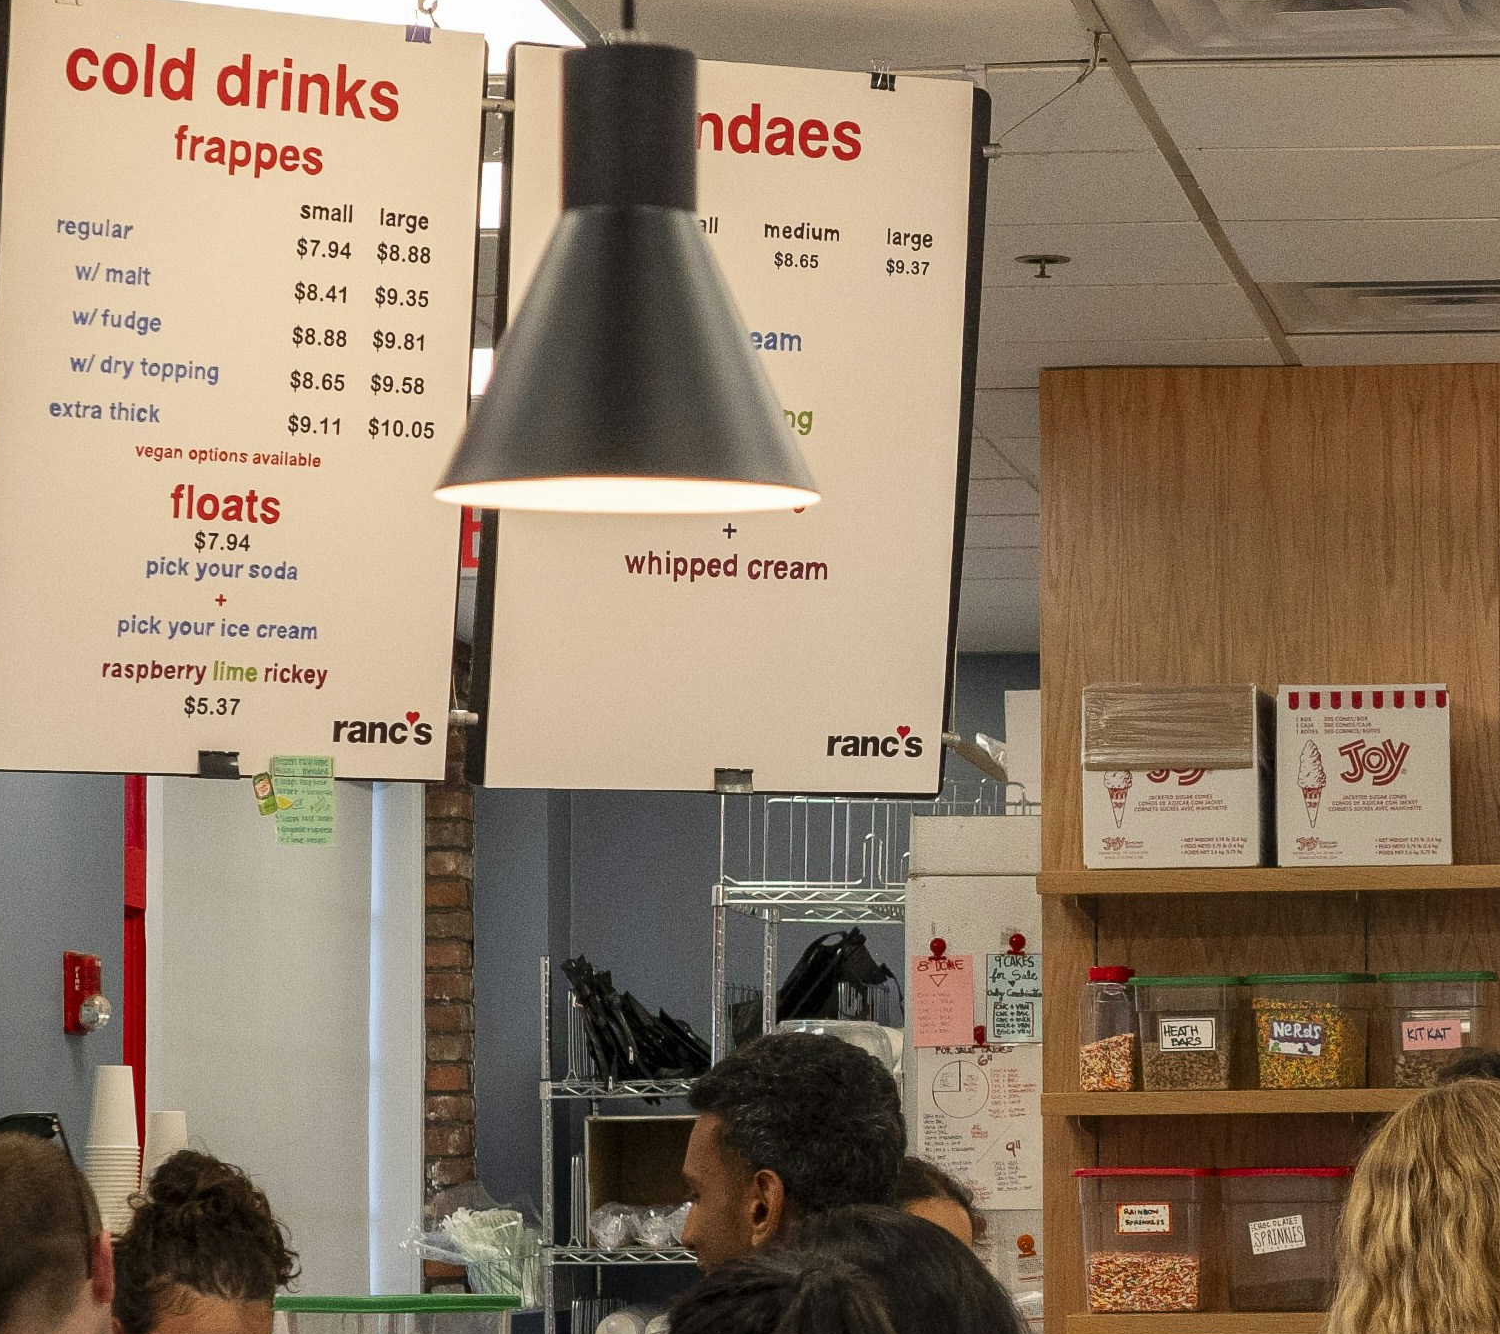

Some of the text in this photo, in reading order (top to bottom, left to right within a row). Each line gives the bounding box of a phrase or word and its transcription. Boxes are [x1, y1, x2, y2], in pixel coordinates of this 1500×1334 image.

[66, 43, 399, 122] cold drinks
[696, 103, 861, 161] ndaes
[175, 124, 323, 178] frappes
[300, 203, 429, 233] small large
[56, 217, 431, 265] regular $7.94 $8.88
[764, 222, 933, 250] medium large
[774, 251, 930, 276] $8.65 $9.37
[49, 400, 434, 439] extra thick $9.11 $10.05
[171, 484, 281, 524] floats
[195, 530, 250, 553] $7.94
[625, 551, 828, 582] whipped cream
[102, 660, 327, 689] raspberry lime rickey
[184, 696, 240, 718] $5.37
[1164, 1024, 1198, 1038] HEATH
[1171, 1036, 1201, 1047] BARS
[1407, 1027, 1452, 1041] KIT KAT
[1254, 1225, 1304, 1247] SPRINKLES
